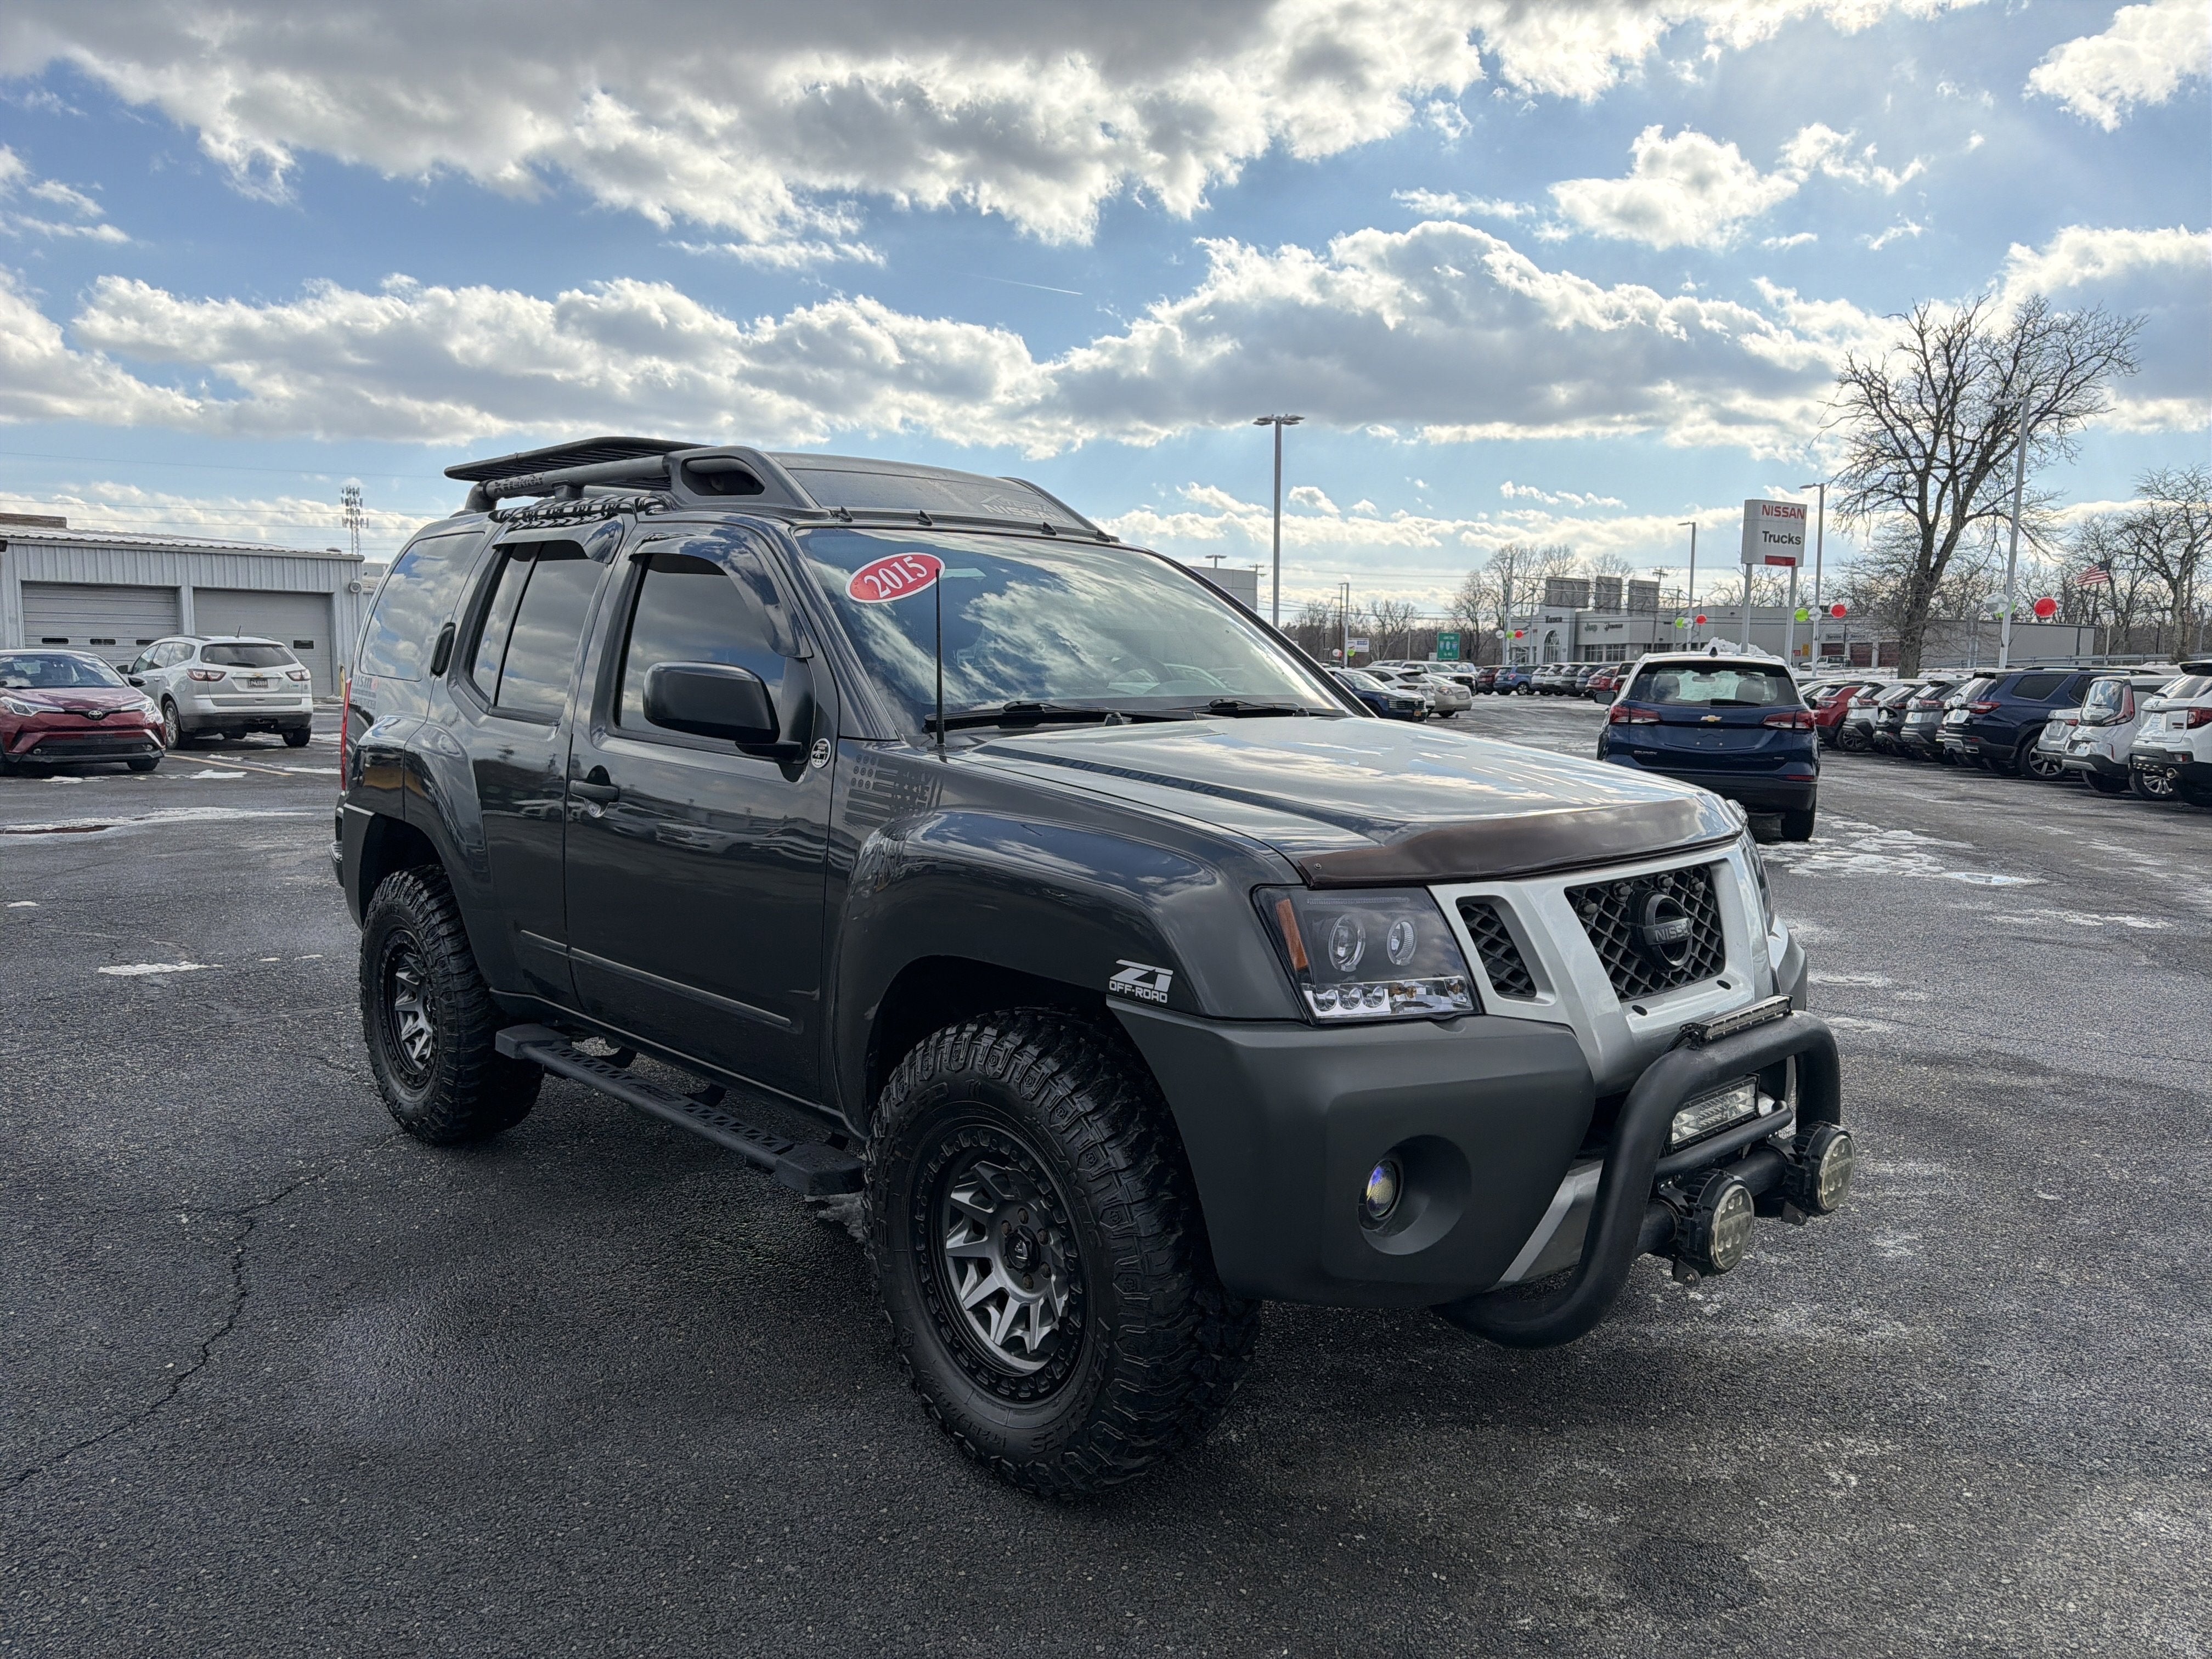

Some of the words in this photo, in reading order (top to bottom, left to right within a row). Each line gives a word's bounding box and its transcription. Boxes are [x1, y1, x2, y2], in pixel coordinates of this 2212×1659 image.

[981, 504, 1070, 523] NISSAN
[1762, 504, 1805, 520] NISSAN
[1762, 530, 1802, 545] Trucks
[864, 556, 927, 598] 2015
[1109, 980, 1168, 1003] OFF-ROAD
